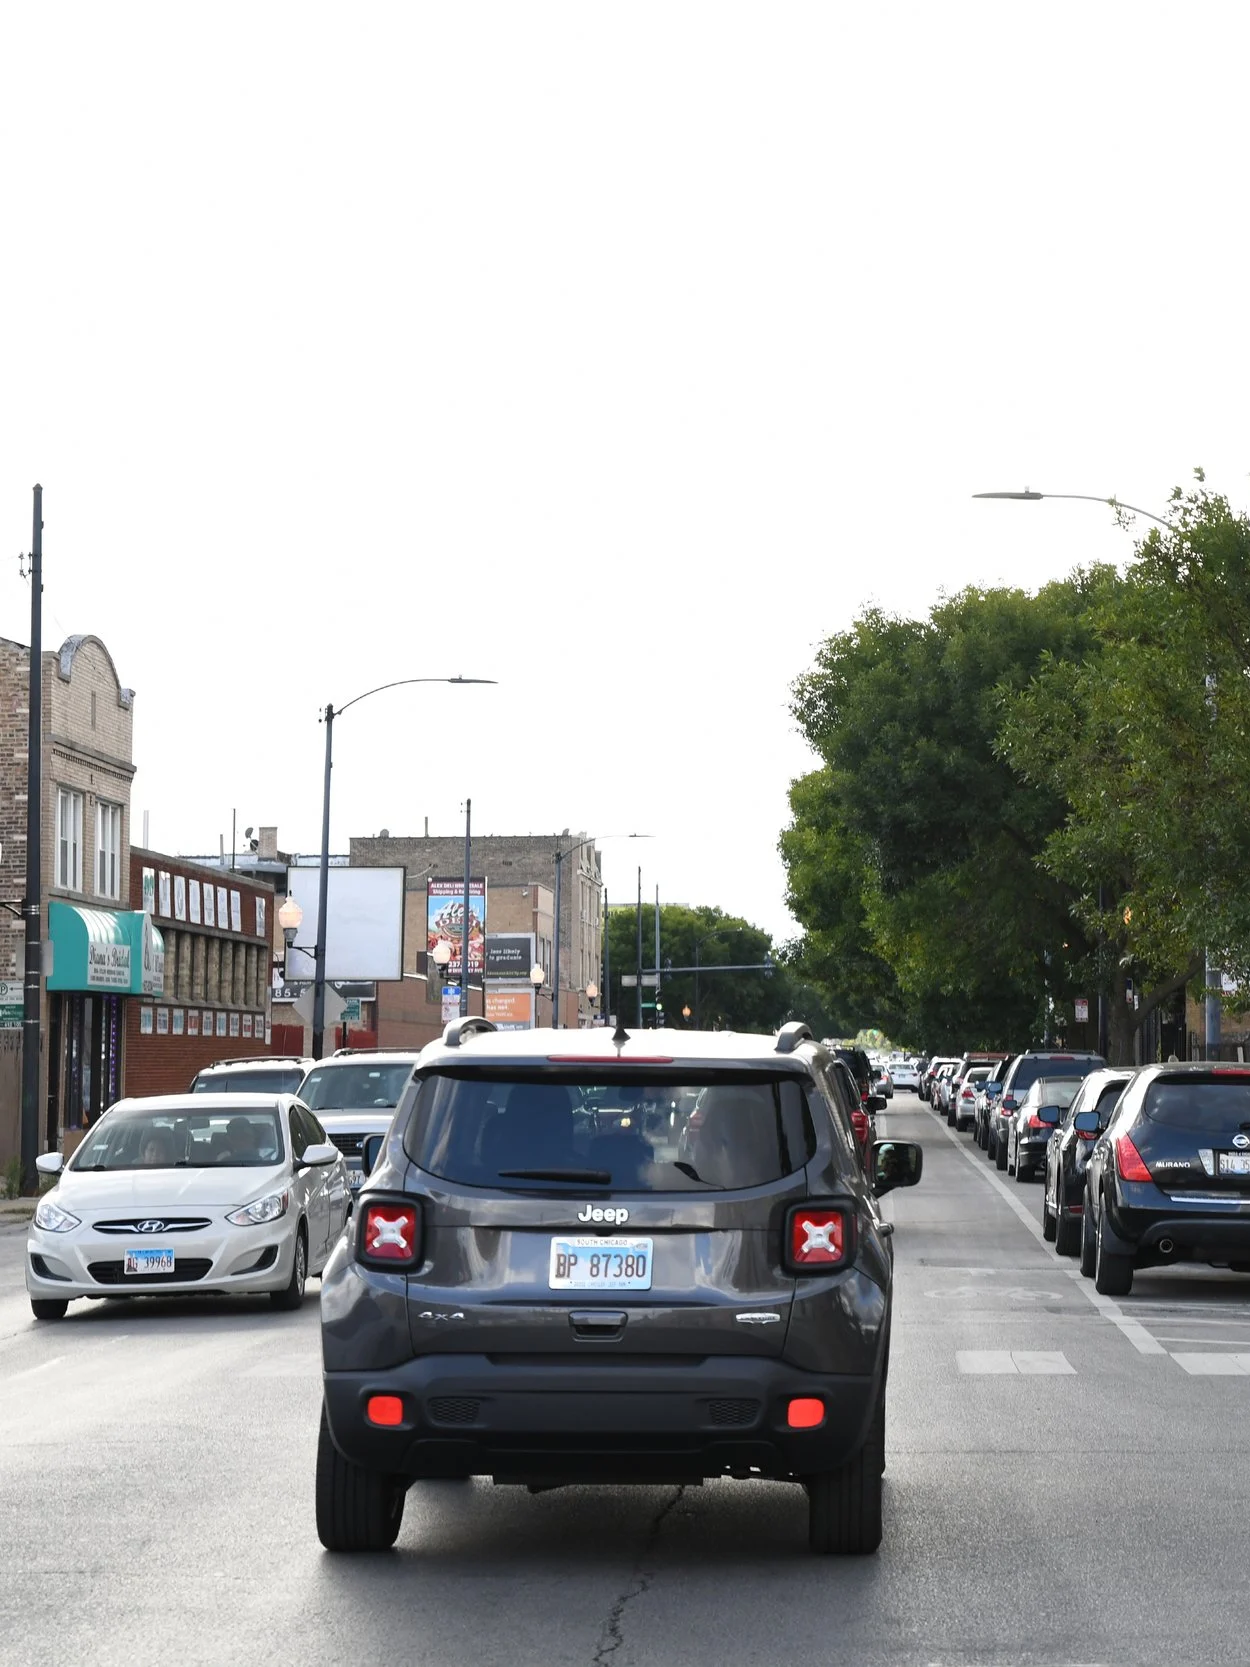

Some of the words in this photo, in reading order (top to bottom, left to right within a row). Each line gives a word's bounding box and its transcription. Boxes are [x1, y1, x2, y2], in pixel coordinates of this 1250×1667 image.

[503, 948, 521, 956] likely
[578, 1204, 629, 1225] Jeep
[555, 1253, 578, 1279] BP
[589, 1253, 647, 1279] 87380
